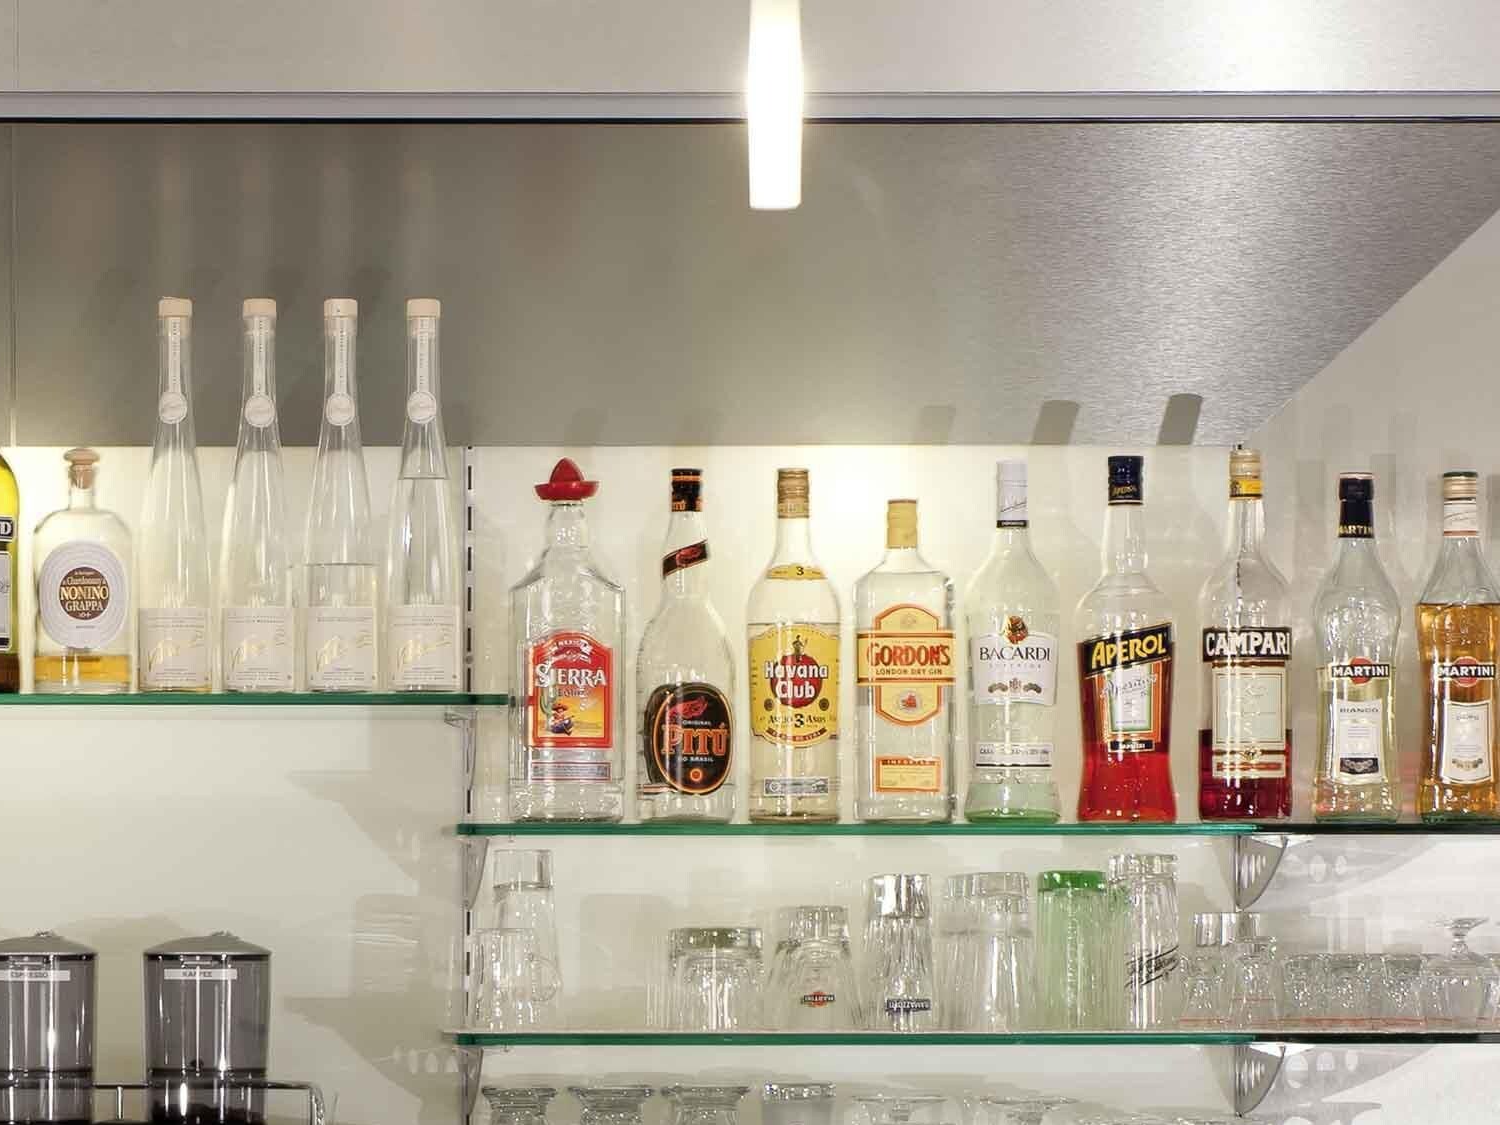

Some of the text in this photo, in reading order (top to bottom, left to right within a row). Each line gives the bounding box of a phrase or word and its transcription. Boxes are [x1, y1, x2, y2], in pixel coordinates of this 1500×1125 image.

[796, 566, 805, 576] 3
[60, 586, 109, 600] NONINO
[66, 601, 104, 612] GRAPPA
[1091, 633, 1167, 669] APEROL
[1206, 632, 1291, 656] CAMPARI
[867, 643, 951, 667] GORDON'S
[979, 647, 1051, 661] BACARDI
[535, 658, 607, 688] SIERRA
[764, 660, 829, 679] Havana
[1333, 666, 1389, 676] MARTINI
[1439, 666, 1494, 677] MARTINI
[775, 680, 816, 698] Club
[794, 713, 805, 728] 3
[661, 722, 730, 756] PITÚ
